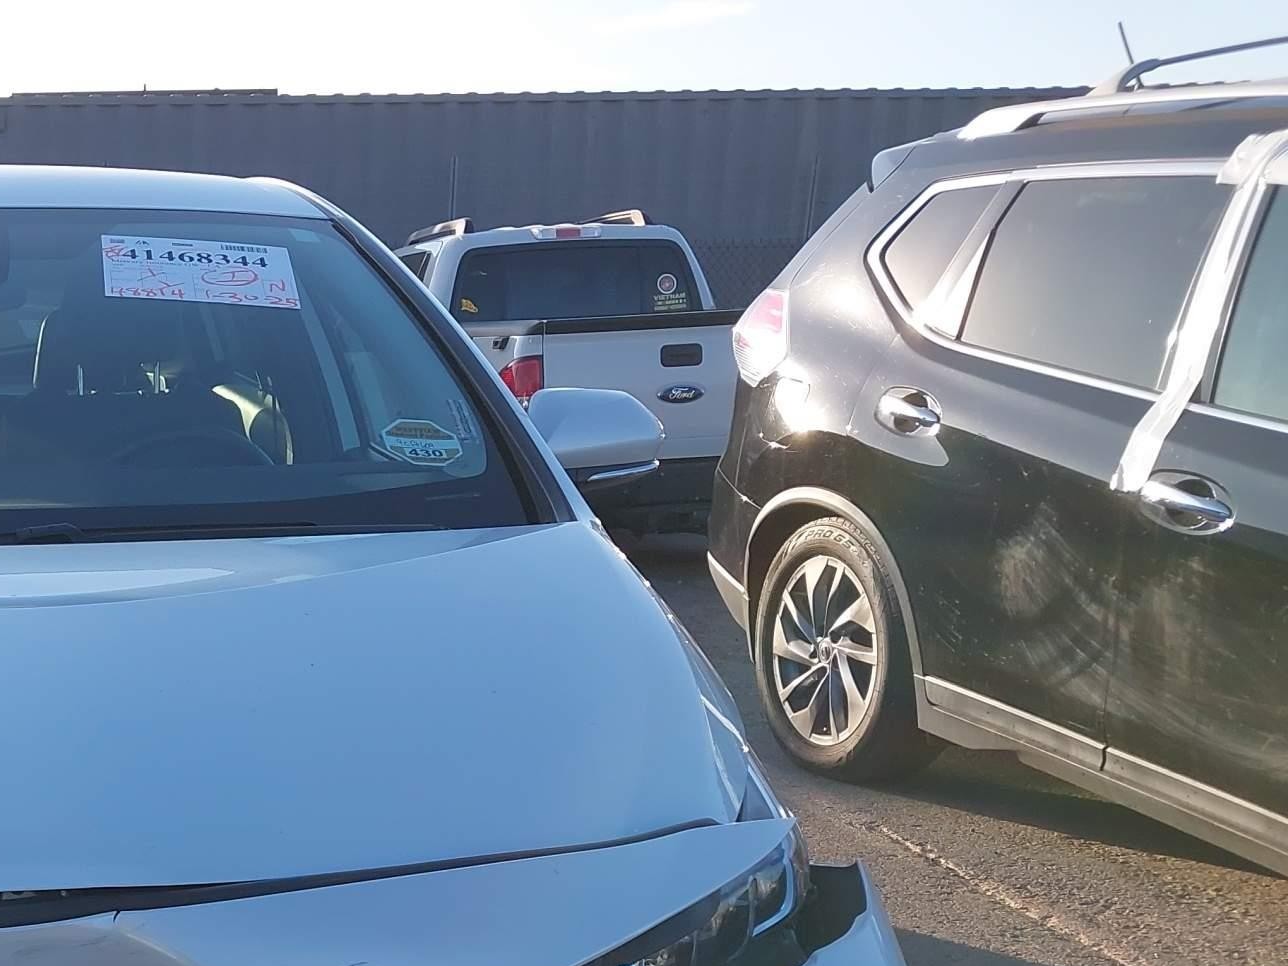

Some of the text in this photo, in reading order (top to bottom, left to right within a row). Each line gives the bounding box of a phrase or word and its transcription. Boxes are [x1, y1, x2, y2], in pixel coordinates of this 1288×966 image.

[122, 248, 269, 268] 41468344
[669, 387, 696, 400] Ford
[408, 448, 444, 457] 430
